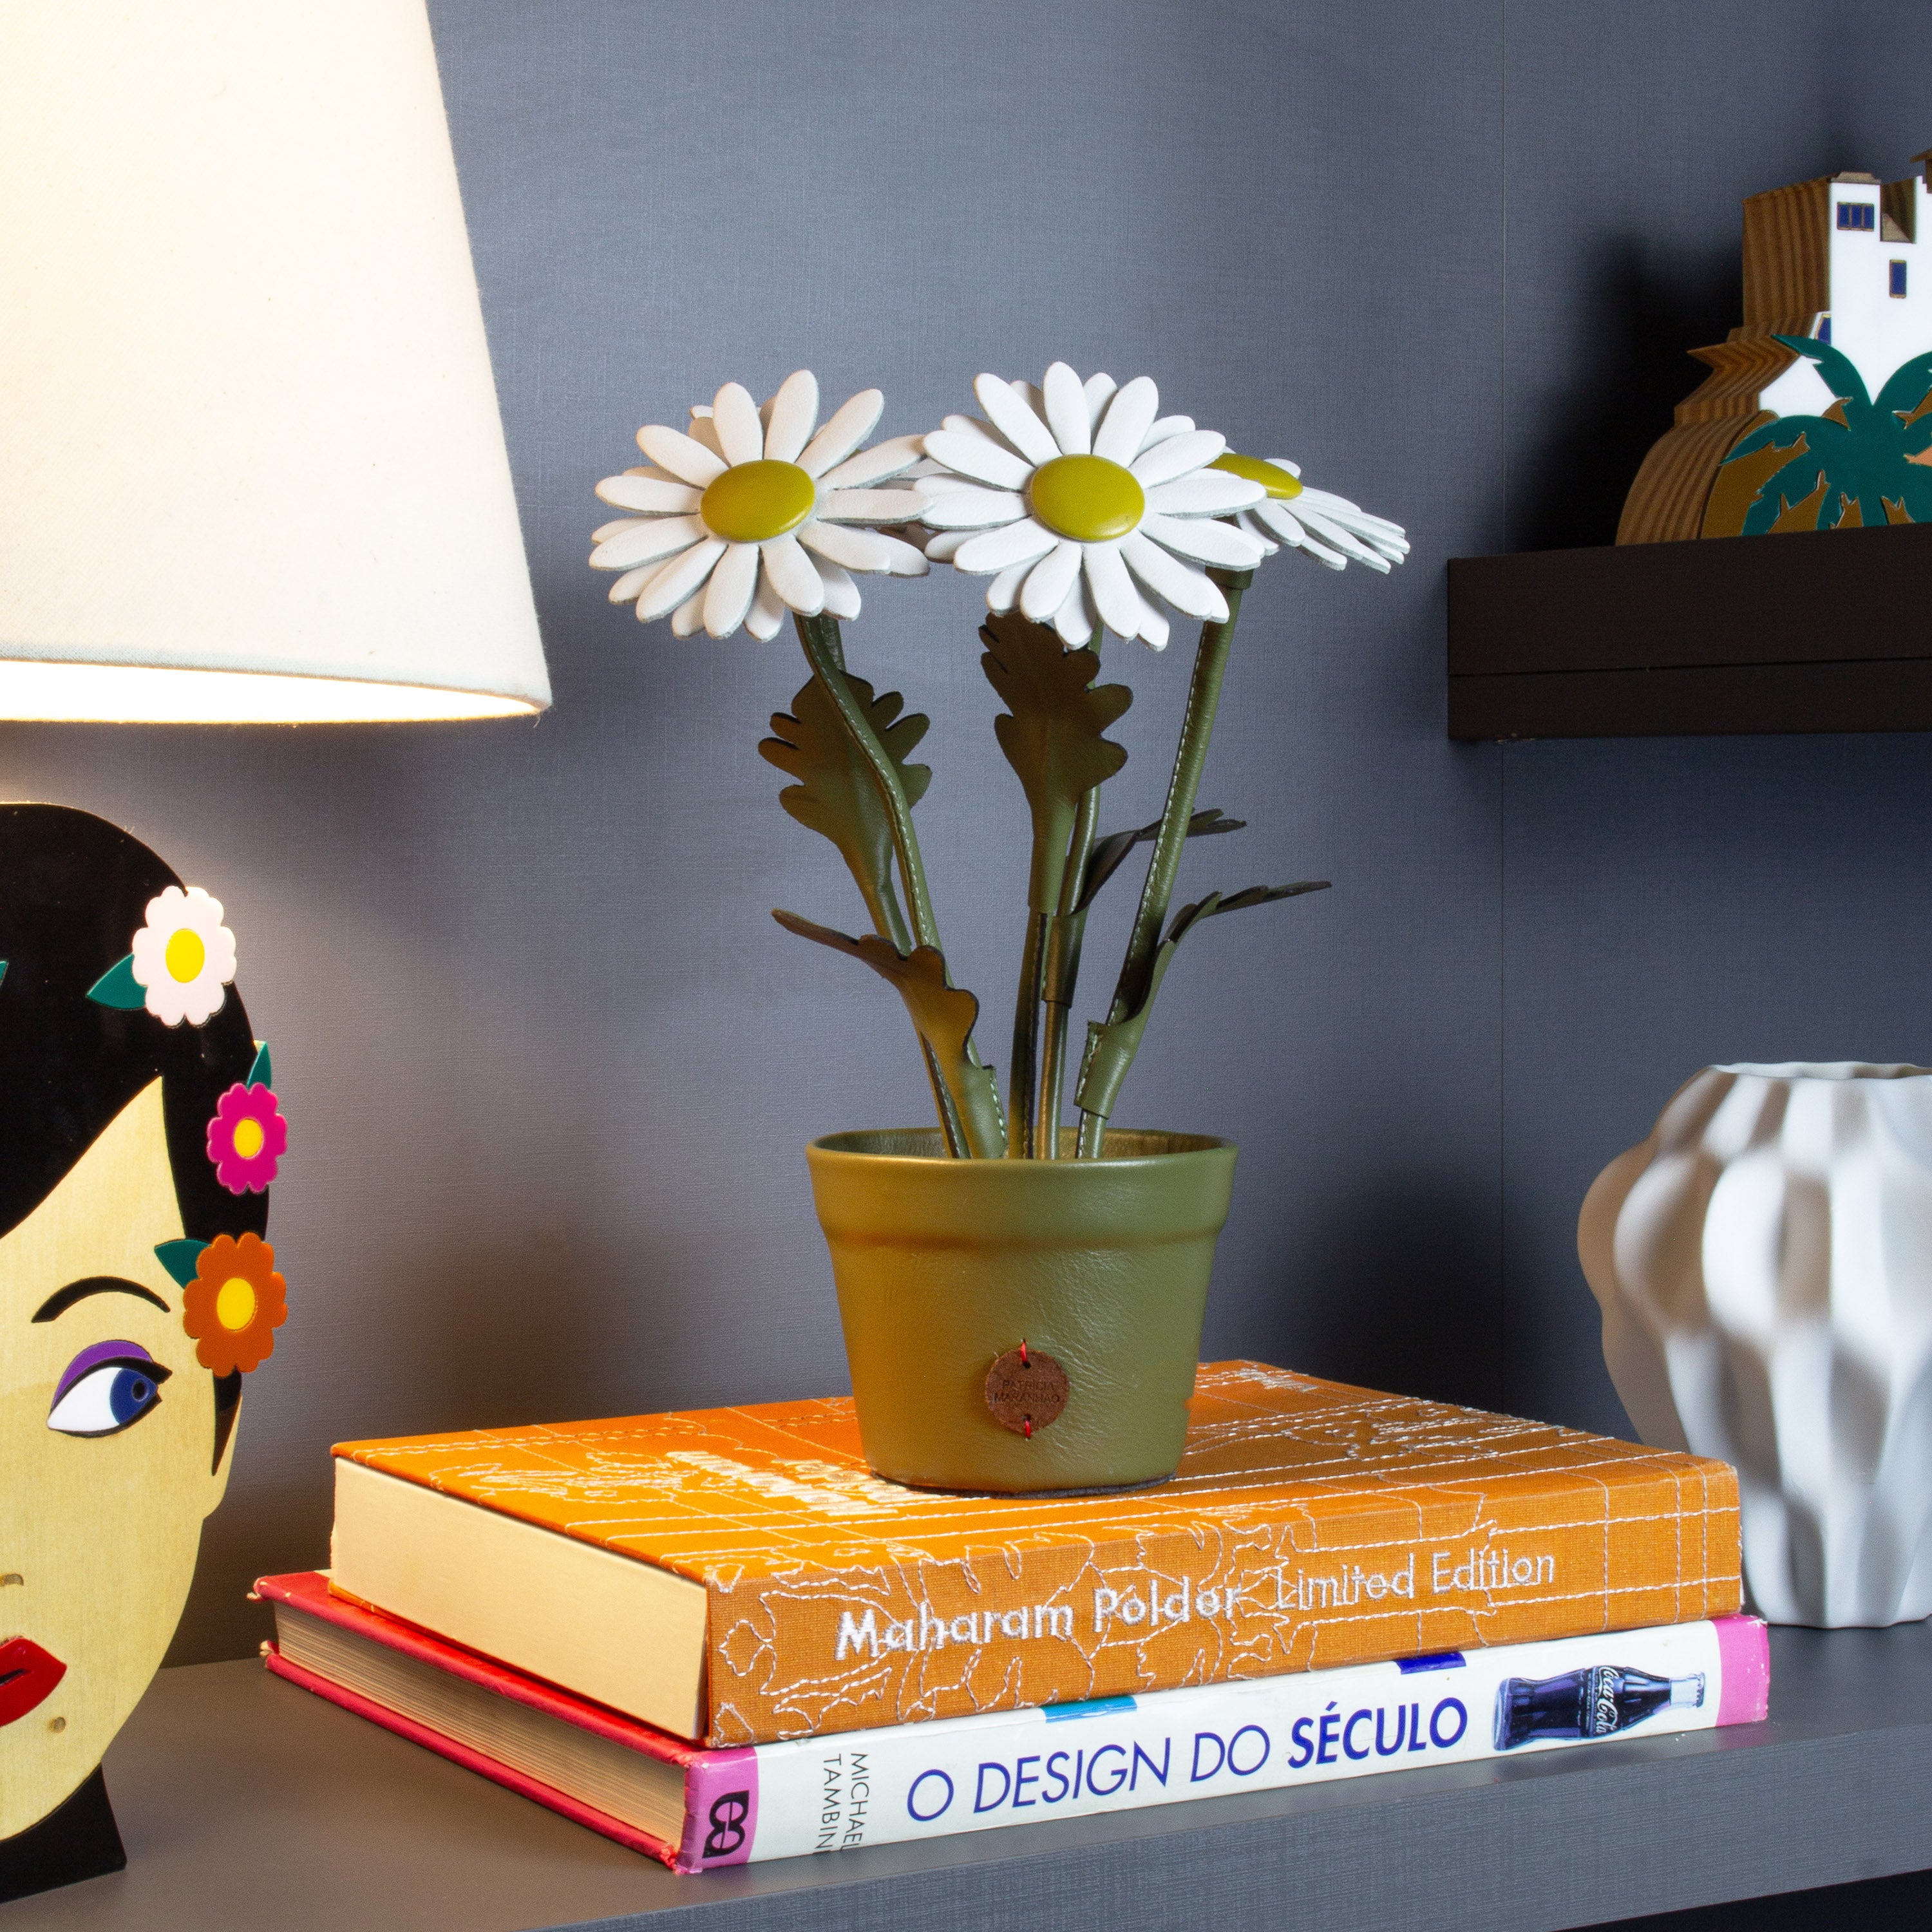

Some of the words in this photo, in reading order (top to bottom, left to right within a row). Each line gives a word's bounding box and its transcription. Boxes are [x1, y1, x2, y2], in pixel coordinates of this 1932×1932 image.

[837, 1602, 1074, 1660] Maharam
[1094, 1575, 1240, 1633] Polder
[1276, 1553, 1414, 1610] Limited
[1432, 1548, 1554, 1593] Edition
[1596, 1666, 1620, 1734] Coca-Cola
[840, 1753, 869, 1850] MICHAEL
[907, 1768, 954, 1821] O
[973, 1738, 1171, 1814] DESIGN
[1190, 1725, 1271, 1782] DO
[1287, 1697, 1468, 1768] SÉCULO
